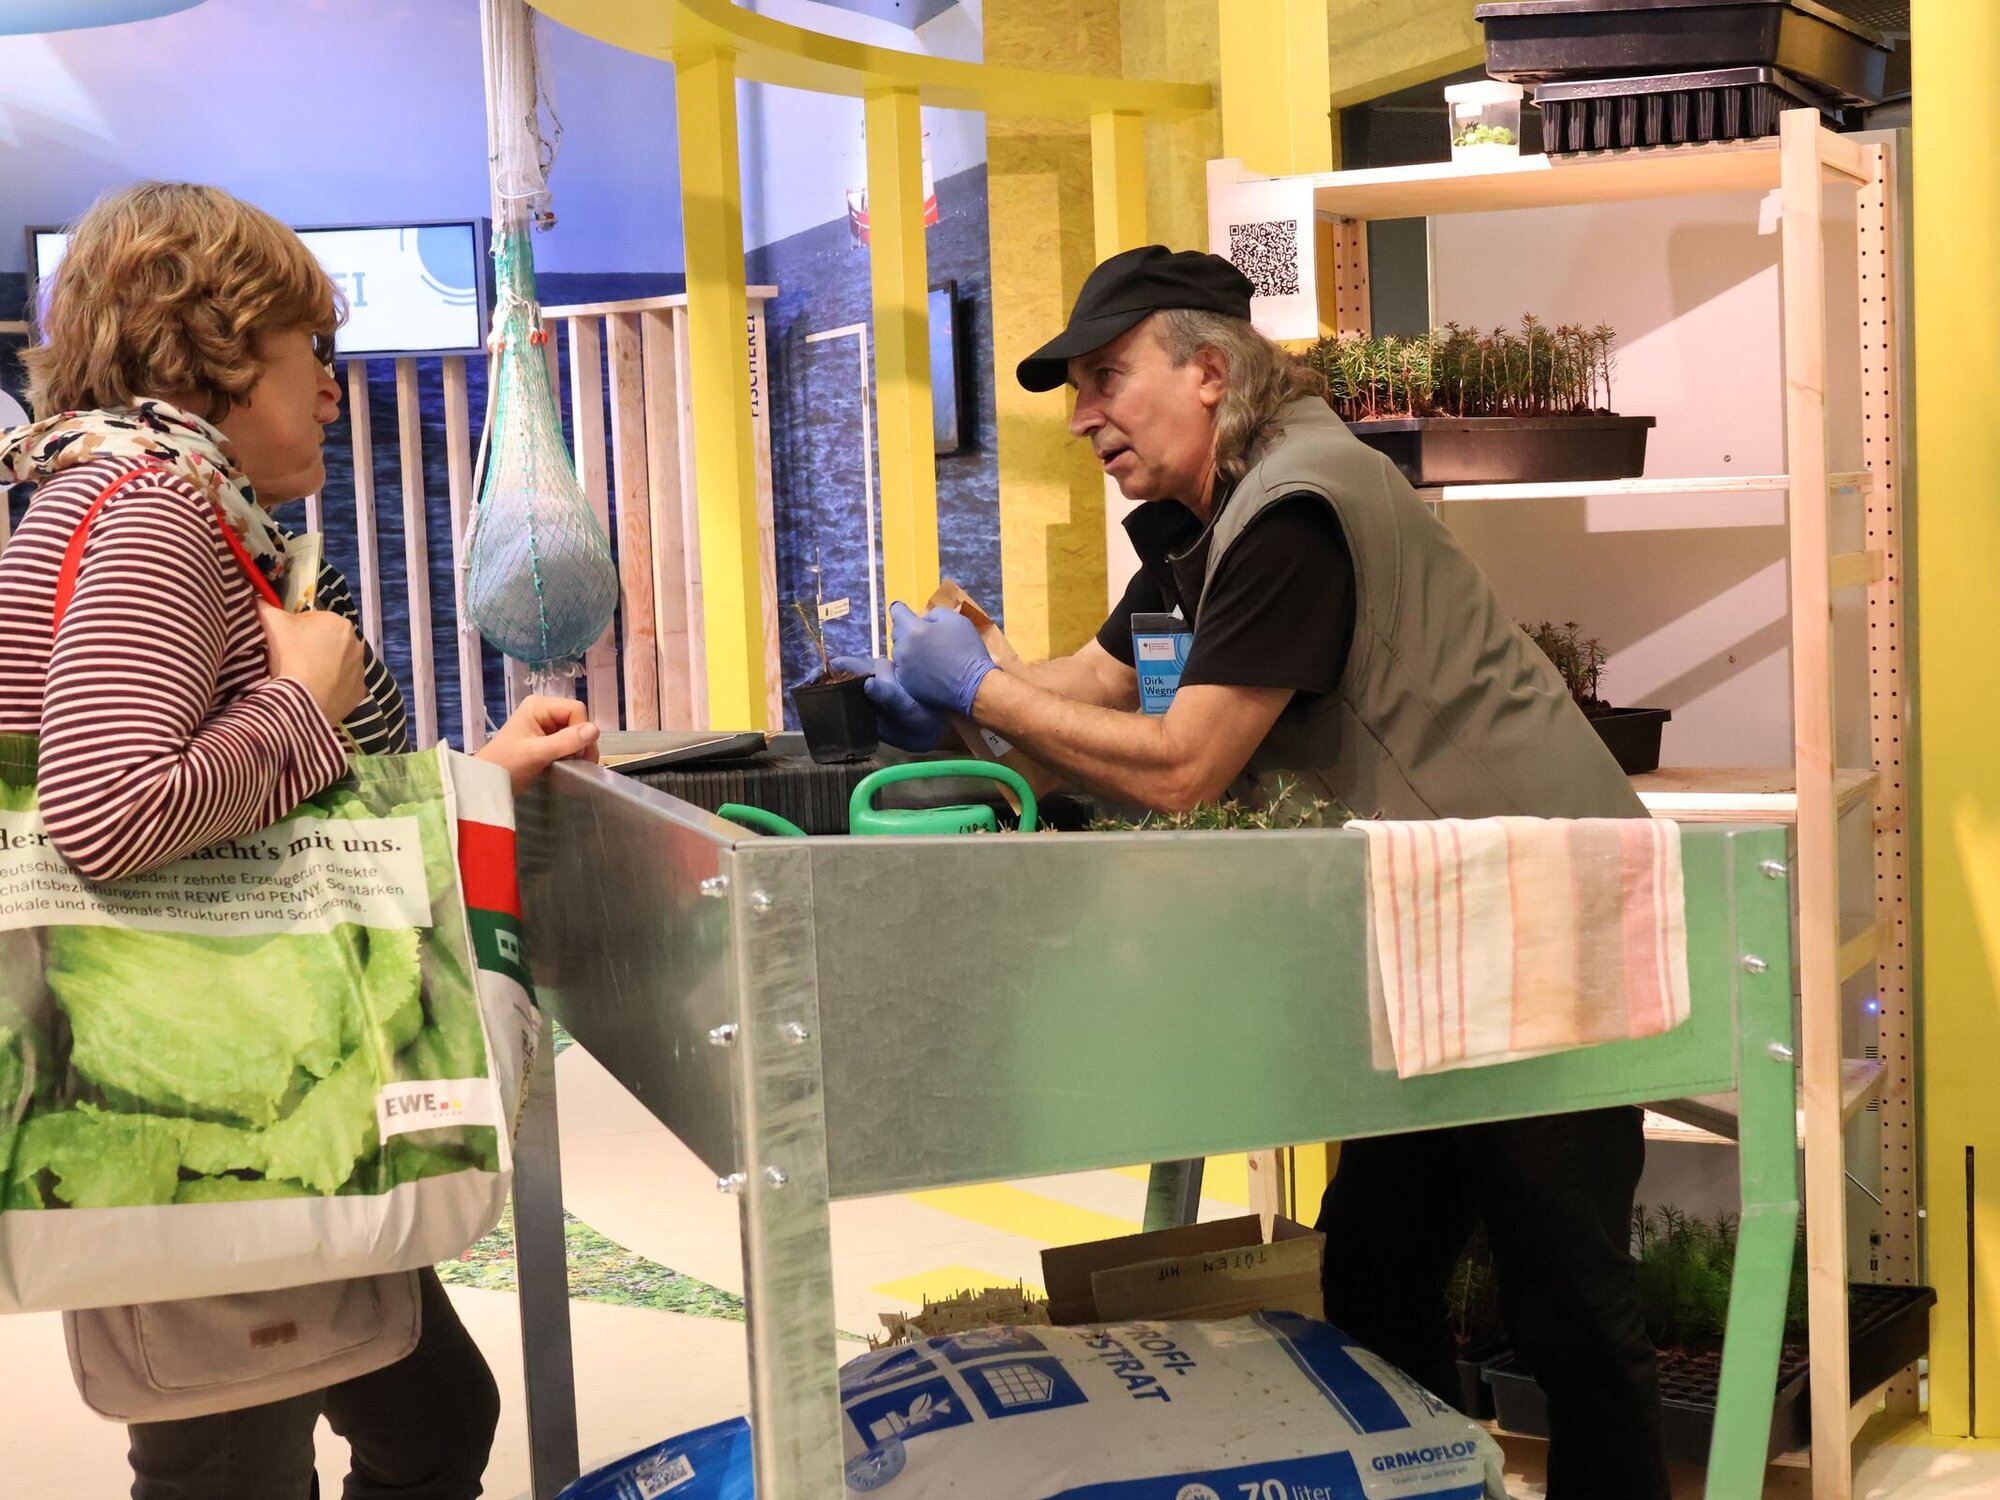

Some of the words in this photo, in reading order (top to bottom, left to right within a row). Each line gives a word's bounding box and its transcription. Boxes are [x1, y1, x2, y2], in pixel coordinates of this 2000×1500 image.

[1144, 676, 1164, 686] Dirk
[288, 831, 336, 857] mit
[342, 838, 402, 853] uns.
[184, 872, 237, 886] zehnte
[326, 863, 378, 878] direkte
[155, 888, 181, 900] mit
[184, 890, 232, 903] REWE
[235, 890, 265, 902] und
[326, 878, 345, 891] So
[348, 883, 405, 896] stärken
[54, 899, 86, 911] und
[90, 900, 163, 917] regionale
[166, 906, 250, 922] Strukturen
[254, 908, 284, 920] und
[1237, 1479, 1289, 1500] 70
[1291, 1484, 1332, 1500] liter
